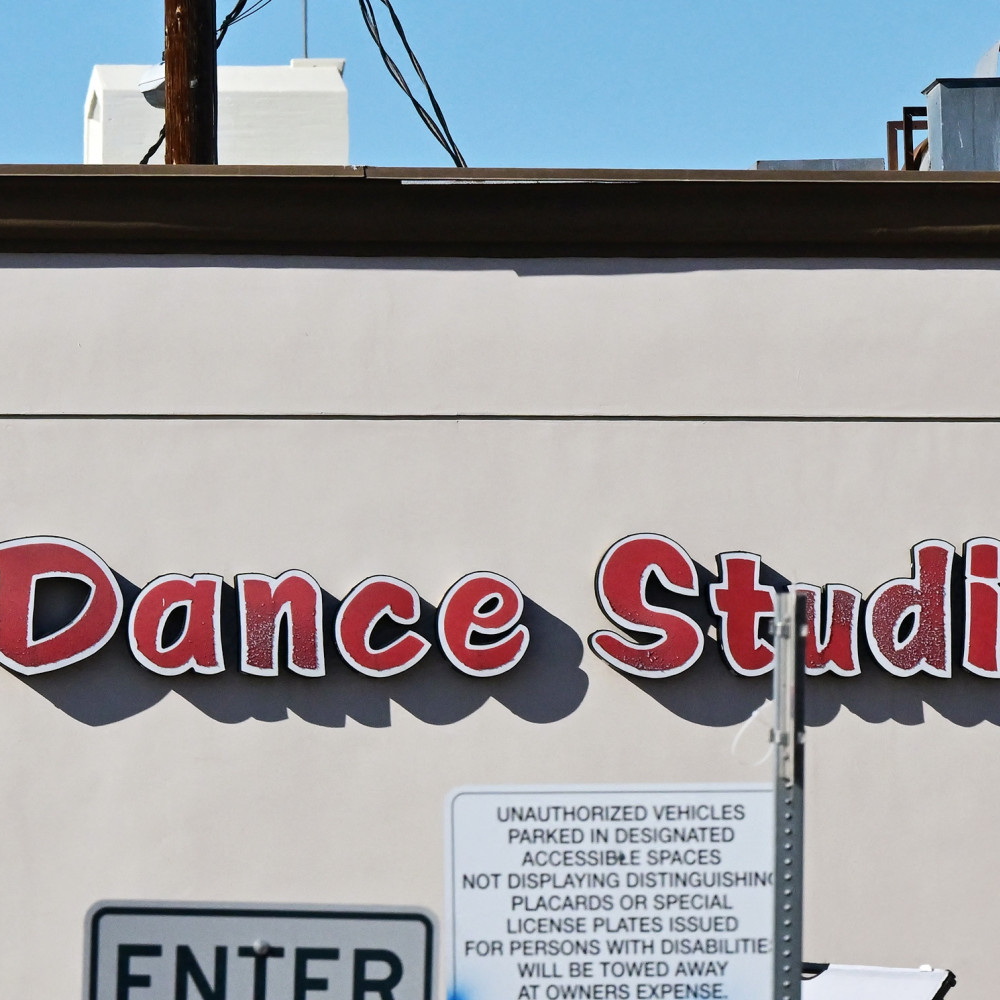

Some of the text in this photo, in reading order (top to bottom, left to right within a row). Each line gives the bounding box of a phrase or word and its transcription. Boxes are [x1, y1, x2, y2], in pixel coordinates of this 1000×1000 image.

[497, 804, 745, 822] UNAUTHORIZED VEHICLES
[508, 827, 735, 845] PARKED IN DESIGNATED
[522, 849, 722, 867] ACCESSIBLE SPACES
[462, 873, 502, 890] NOT
[508, 872, 620, 889] DISPLAYING
[511, 894, 733, 912] PLACARDS OR SPECIAL
[507, 916, 739, 934] LICENSE PLATES ISSUED
[465, 940, 503, 957] FOR
[510, 939, 601, 956] PERSONS
[607, 939, 654, 955] WITH
[518, 961, 729, 979] WILL BE TOWED AWAY
[518, 983, 728, 1000] AT OWNERS EXPENSE.
